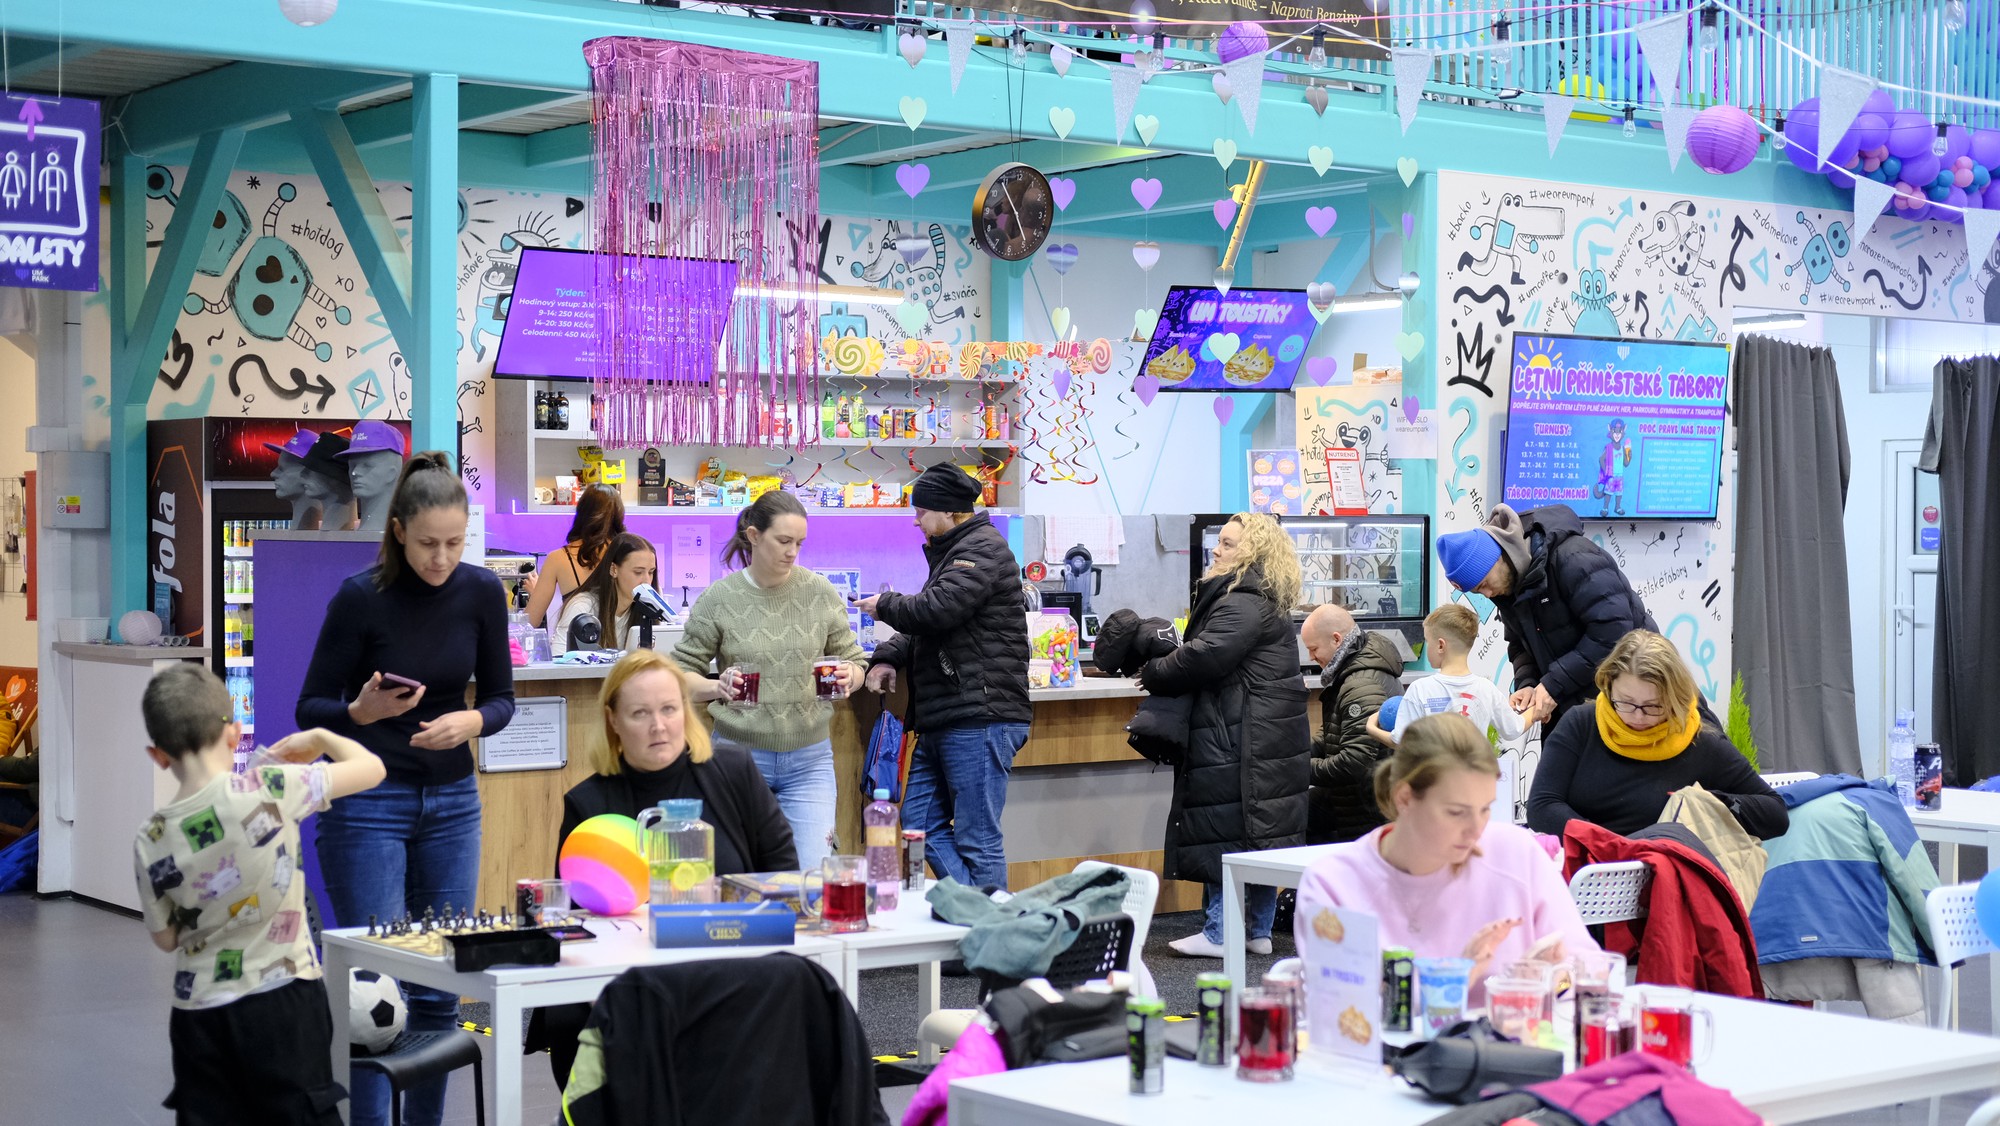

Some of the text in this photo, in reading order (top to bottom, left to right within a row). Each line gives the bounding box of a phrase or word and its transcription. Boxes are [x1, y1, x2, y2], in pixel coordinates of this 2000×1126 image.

[1270, 1, 1313, 20] Naproti
[1316, 8, 1362, 28] Benziny
[1037, 193, 1042, 201] 2
[986, 224, 991, 232] 8
[1033, 228, 1038, 236] 4
[291, 219, 344, 260] #hotdog
[1609, 222, 1644, 281] #narozeniny
[1942, 248, 1969, 287] #worksh
[32, 275, 49, 283] PARK
[555, 288, 587, 298] Týden:
[519, 298, 556, 308] Hodinový
[557, 300, 580, 309] vstup:
[1189, 299, 1292, 324] UM TOUSTÍKY
[1544, 297, 1560, 332] coffee
[522, 328, 563, 337] Celodenní:
[1513, 361, 1725, 400] LETNÍ PŘÍMĚSTSKÉ TÁBORY
[1512, 401, 1539, 410] DOPŘEJTE
[1540, 402, 1556, 411] SVÝM
[1556, 402, 1573, 411] DĚTEM
[1573, 403, 1586, 411] LÉTO
[1586, 404, 1601, 412] PLNÉ
[1395, 425, 1429, 433] weareumpark
[1533, 422, 1573, 437] TURNUSY:
[1638, 421, 1657, 434] PROČ
[1253, 475, 1284, 486] PIZZA
[1507, 484, 1589, 500] TÁBOR PRO NEJMENŠÍ
